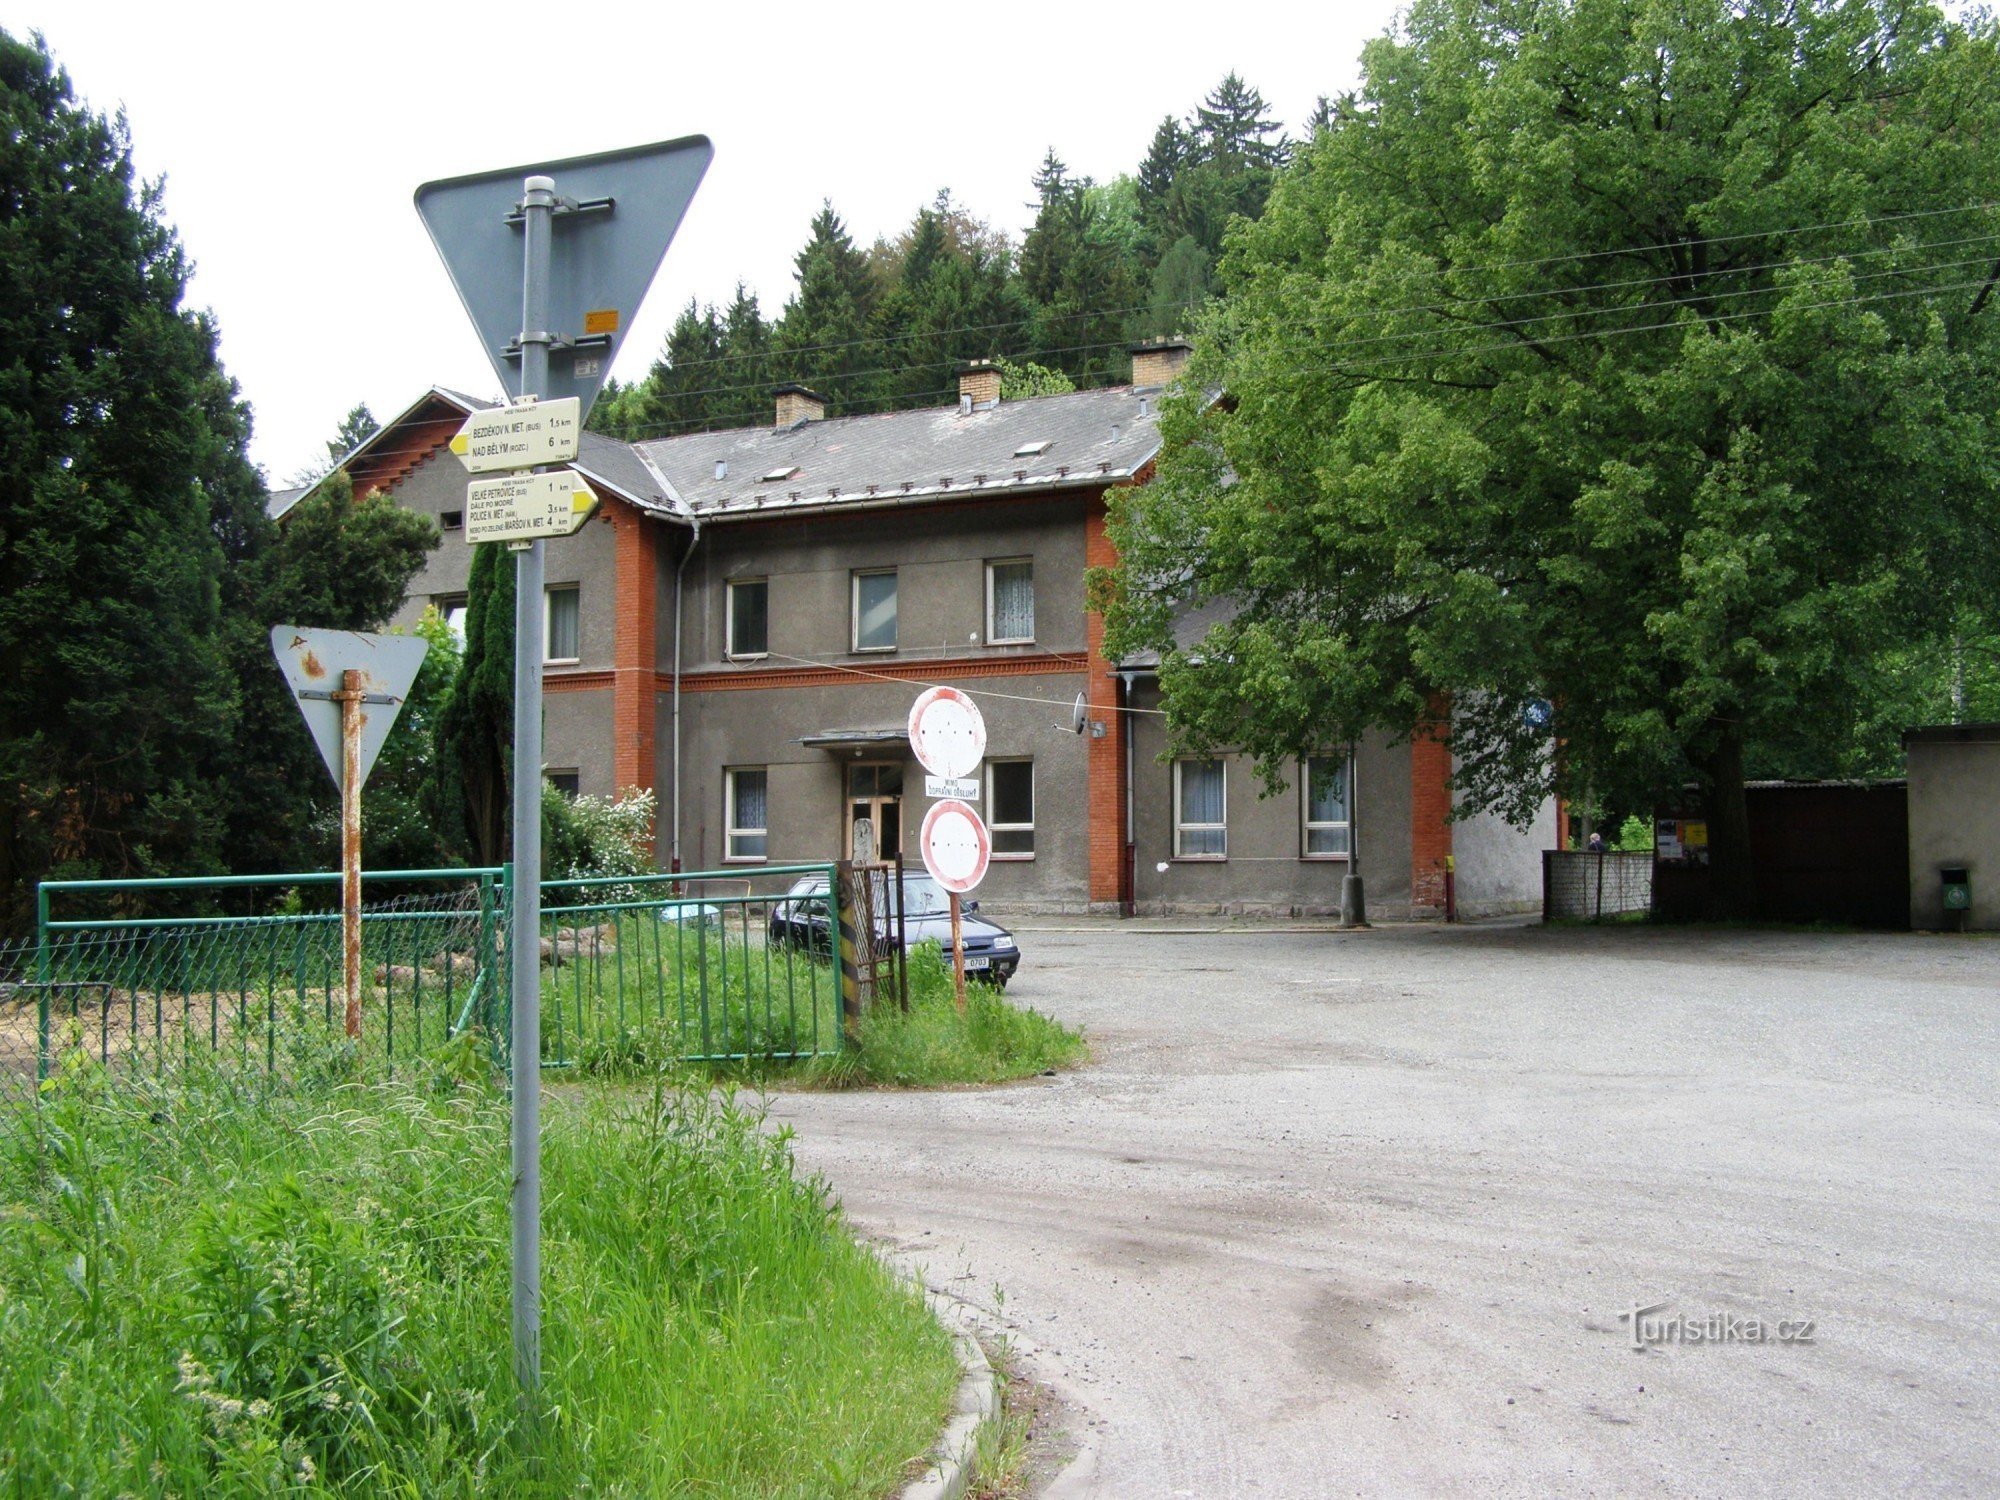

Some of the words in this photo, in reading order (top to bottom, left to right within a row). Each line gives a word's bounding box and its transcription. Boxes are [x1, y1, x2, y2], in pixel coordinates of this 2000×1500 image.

[473, 424, 505, 439] BEZDĚKOV
[504, 424, 510, 434] N.
[511, 422, 524, 433] MET.
[525, 423, 542, 432] (BUS)
[550, 418, 560, 428] 1,5
[472, 446, 485, 457] NAD
[487, 442, 509, 456] BĚLÝM
[548, 437, 555, 447] 6
[471, 489, 487, 501] VELKÉ
[488, 487, 515, 498] PETROVICE
[549, 482, 553, 492] 1
[470, 502, 484, 510] DÁLE
[494, 498, 514, 507] MODRÉ
[470, 511, 487, 522] POLICE
[487, 510, 493, 520] N.
[493, 509, 504, 519] MET.
[547, 504, 558, 514] 3,5
[505, 517, 526, 530] MARŠOV
[526, 519, 532, 528] N.
[533, 517, 544, 528] MET.
[547, 516, 553, 526] 4
